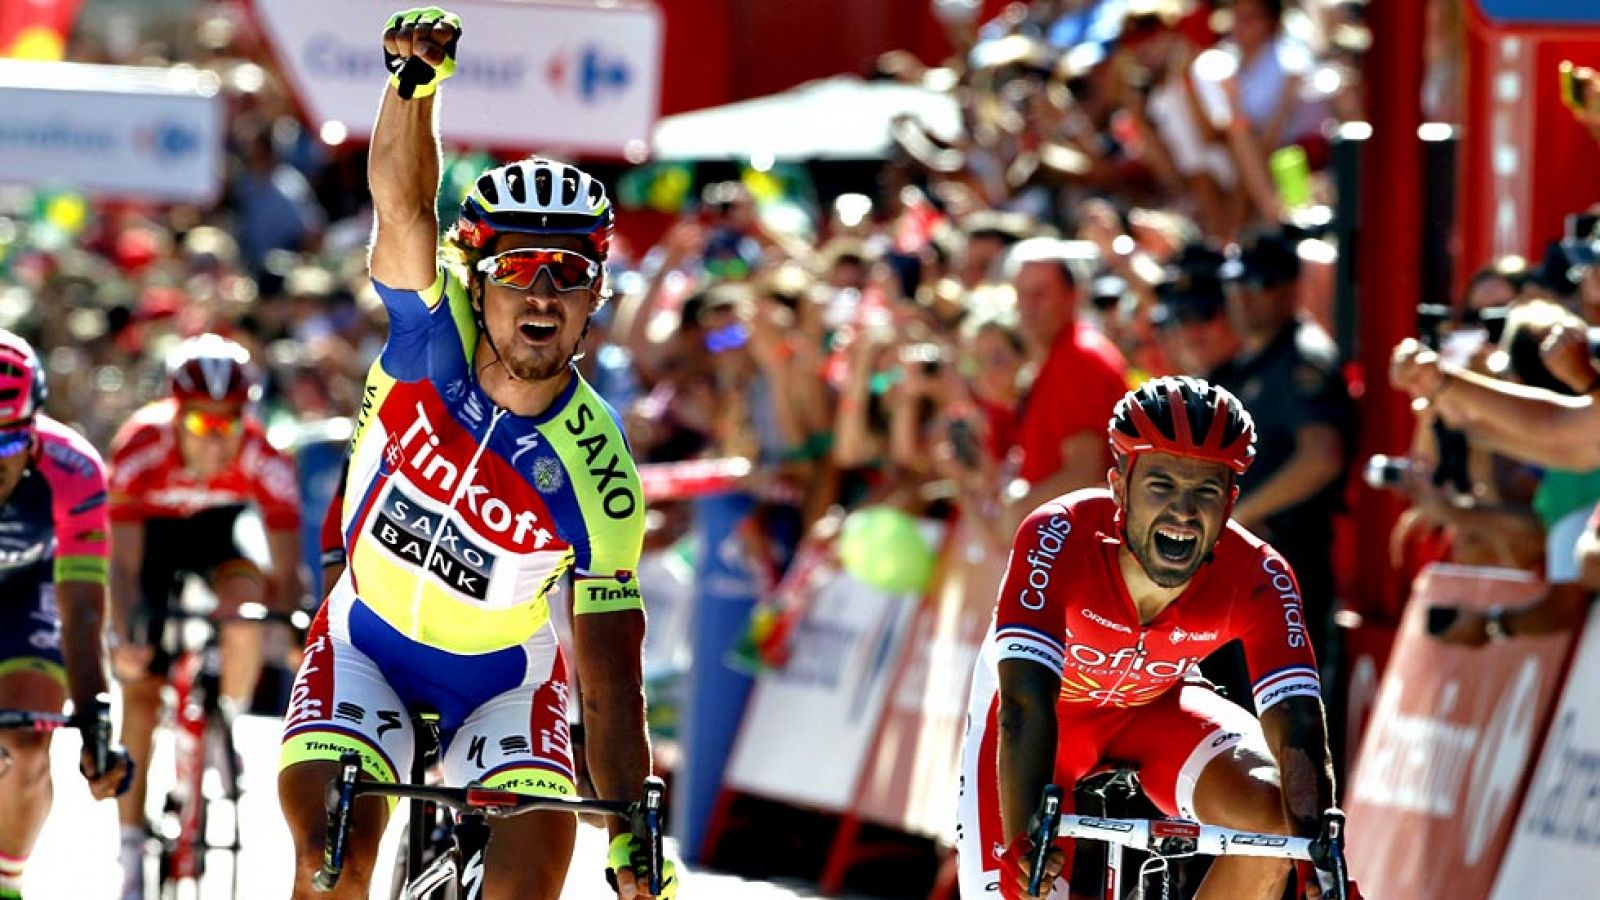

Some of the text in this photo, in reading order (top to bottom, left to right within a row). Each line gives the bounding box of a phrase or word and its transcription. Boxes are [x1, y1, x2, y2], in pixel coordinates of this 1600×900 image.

[399, 401, 553, 550] Tinkoff
[565, 403, 636, 520] SAXO
[381, 524, 478, 594] BANK
[391, 501, 485, 568] SAXO
[1020, 515, 1072, 611] Cofidis
[1081, 608, 1133, 634] ORBEA
[1262, 555, 1306, 648] Cofidis
